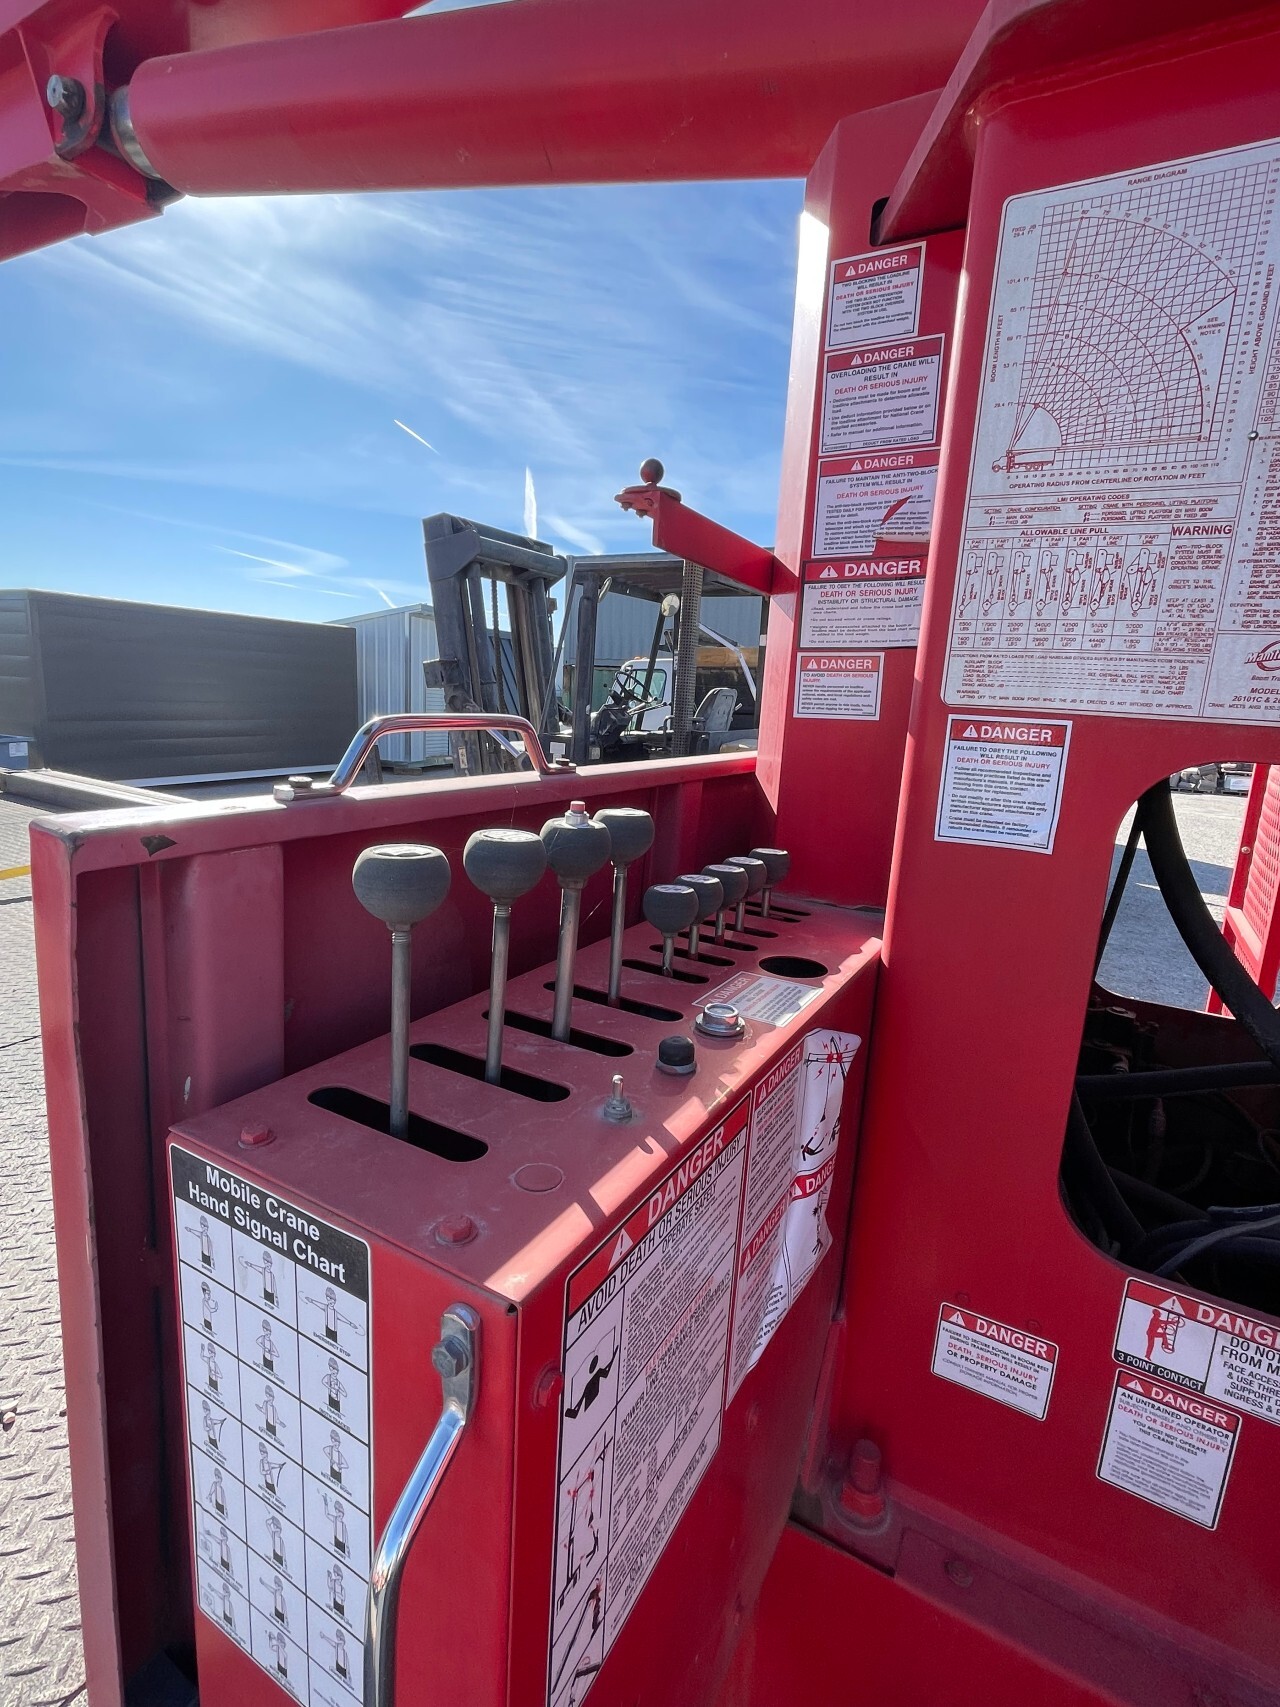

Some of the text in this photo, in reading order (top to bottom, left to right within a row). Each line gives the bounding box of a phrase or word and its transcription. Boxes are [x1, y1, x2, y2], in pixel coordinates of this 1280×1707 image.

[1127, 168, 1188, 186] RANGE DIAGRAM
[858, 254, 908, 274] DANGER
[836, 292, 854, 301] DEATH
[864, 286, 891, 296] SERIOUS
[891, 281, 914, 291] INJURY
[1249, 264, 1275, 375] HEIGHT ABOVE GROUND IN FEET
[864, 345, 914, 364] DANGER
[992, 337, 1001, 362] LENGTH
[831, 357, 935, 380] OVERLOADING THE CRANE WILL
[864, 373, 888, 383] RESULT
[990, 363, 998, 383] BOOM
[835, 375, 928, 395] DEATH OR SERIOUS INJURY
[864, 455, 914, 469] DANGER
[825, 477, 846, 485] FAILURE
[854, 474, 880, 482] MAINTAIN
[1009, 481, 1045, 489] OPERATING
[1090, 477, 1132, 485] CENTERLINE
[1143, 474, 1178, 482] ROTATION
[836, 491, 858, 500] DEATH
[869, 487, 899, 496] SERIOUS
[899, 485, 924, 493] INJURY
[1088, 527, 1109, 535] PULL
[1171, 525, 1233, 536] WARNING
[844, 559, 921, 577] DANGER
[820, 587, 918, 598] DEATH OR SERIOUS INJURY
[820, 660, 872, 669] DANGER
[980, 726, 1052, 742] DANGER
[991, 759, 1023, 767] SERIOUS
[1019, 749, 1057, 757] FOLLOWING
[719, 977, 752, 1000] DANGER
[768, 1047, 800, 1093] DANGER
[648, 1126, 725, 1228] DANGER
[206, 1165, 320, 1241] Mobile Crane
[188, 1180, 346, 1284] Hand Signal Chart
[578, 1134, 741, 1332] AVOID DEATH OR SERIOUS INJURY
[661, 1209, 694, 1254] OPERATE
[752, 1199, 787, 1252] DANGER
[976, 1318, 1047, 1358] DANGER
[1230, 1336, 1250, 1352] DO
[942, 1327, 962, 1339] FAILURE
[962, 1334, 970, 1342] TO
[970, 1337, 991, 1350] SECURE
[990, 1345, 1009, 1357] BOOM
[1016, 1355, 1036, 1367] BOOM
[1036, 1363, 1049, 1373] REST
[1220, 1345, 1262, 1370] FROM
[946, 1350, 958, 1359] OR
[958, 1354, 999, 1375] PROPERTY
[998, 1370, 1037, 1391] DAMAGE
[975, 1353, 1008, 1371] SERIOUS
[1009, 1366, 1039, 1383] INJURY
[1118, 1352, 1204, 1392] 3 POINT CONTACT
[1223, 1361, 1246, 1376] FACE
[1227, 1371, 1233, 1380] &
[1236, 1375, 1257, 1387] USE
[1223, 1388, 1272, 1413] INGRESS &
[1230, 1382, 1273, 1403] SUPPORT
[1120, 1391, 1230, 1441] AN UNTRAINED OPERATOR
[1150, 1386, 1228, 1428] DANGER
[1117, 1403, 1227, 1454] DEATH OR SERIOUS INJURY
[1132, 1419, 1208, 1454] YOU MUST NOT OPERATE
[1138, 1428, 1198, 1456] THIS CRANE UNLESS
